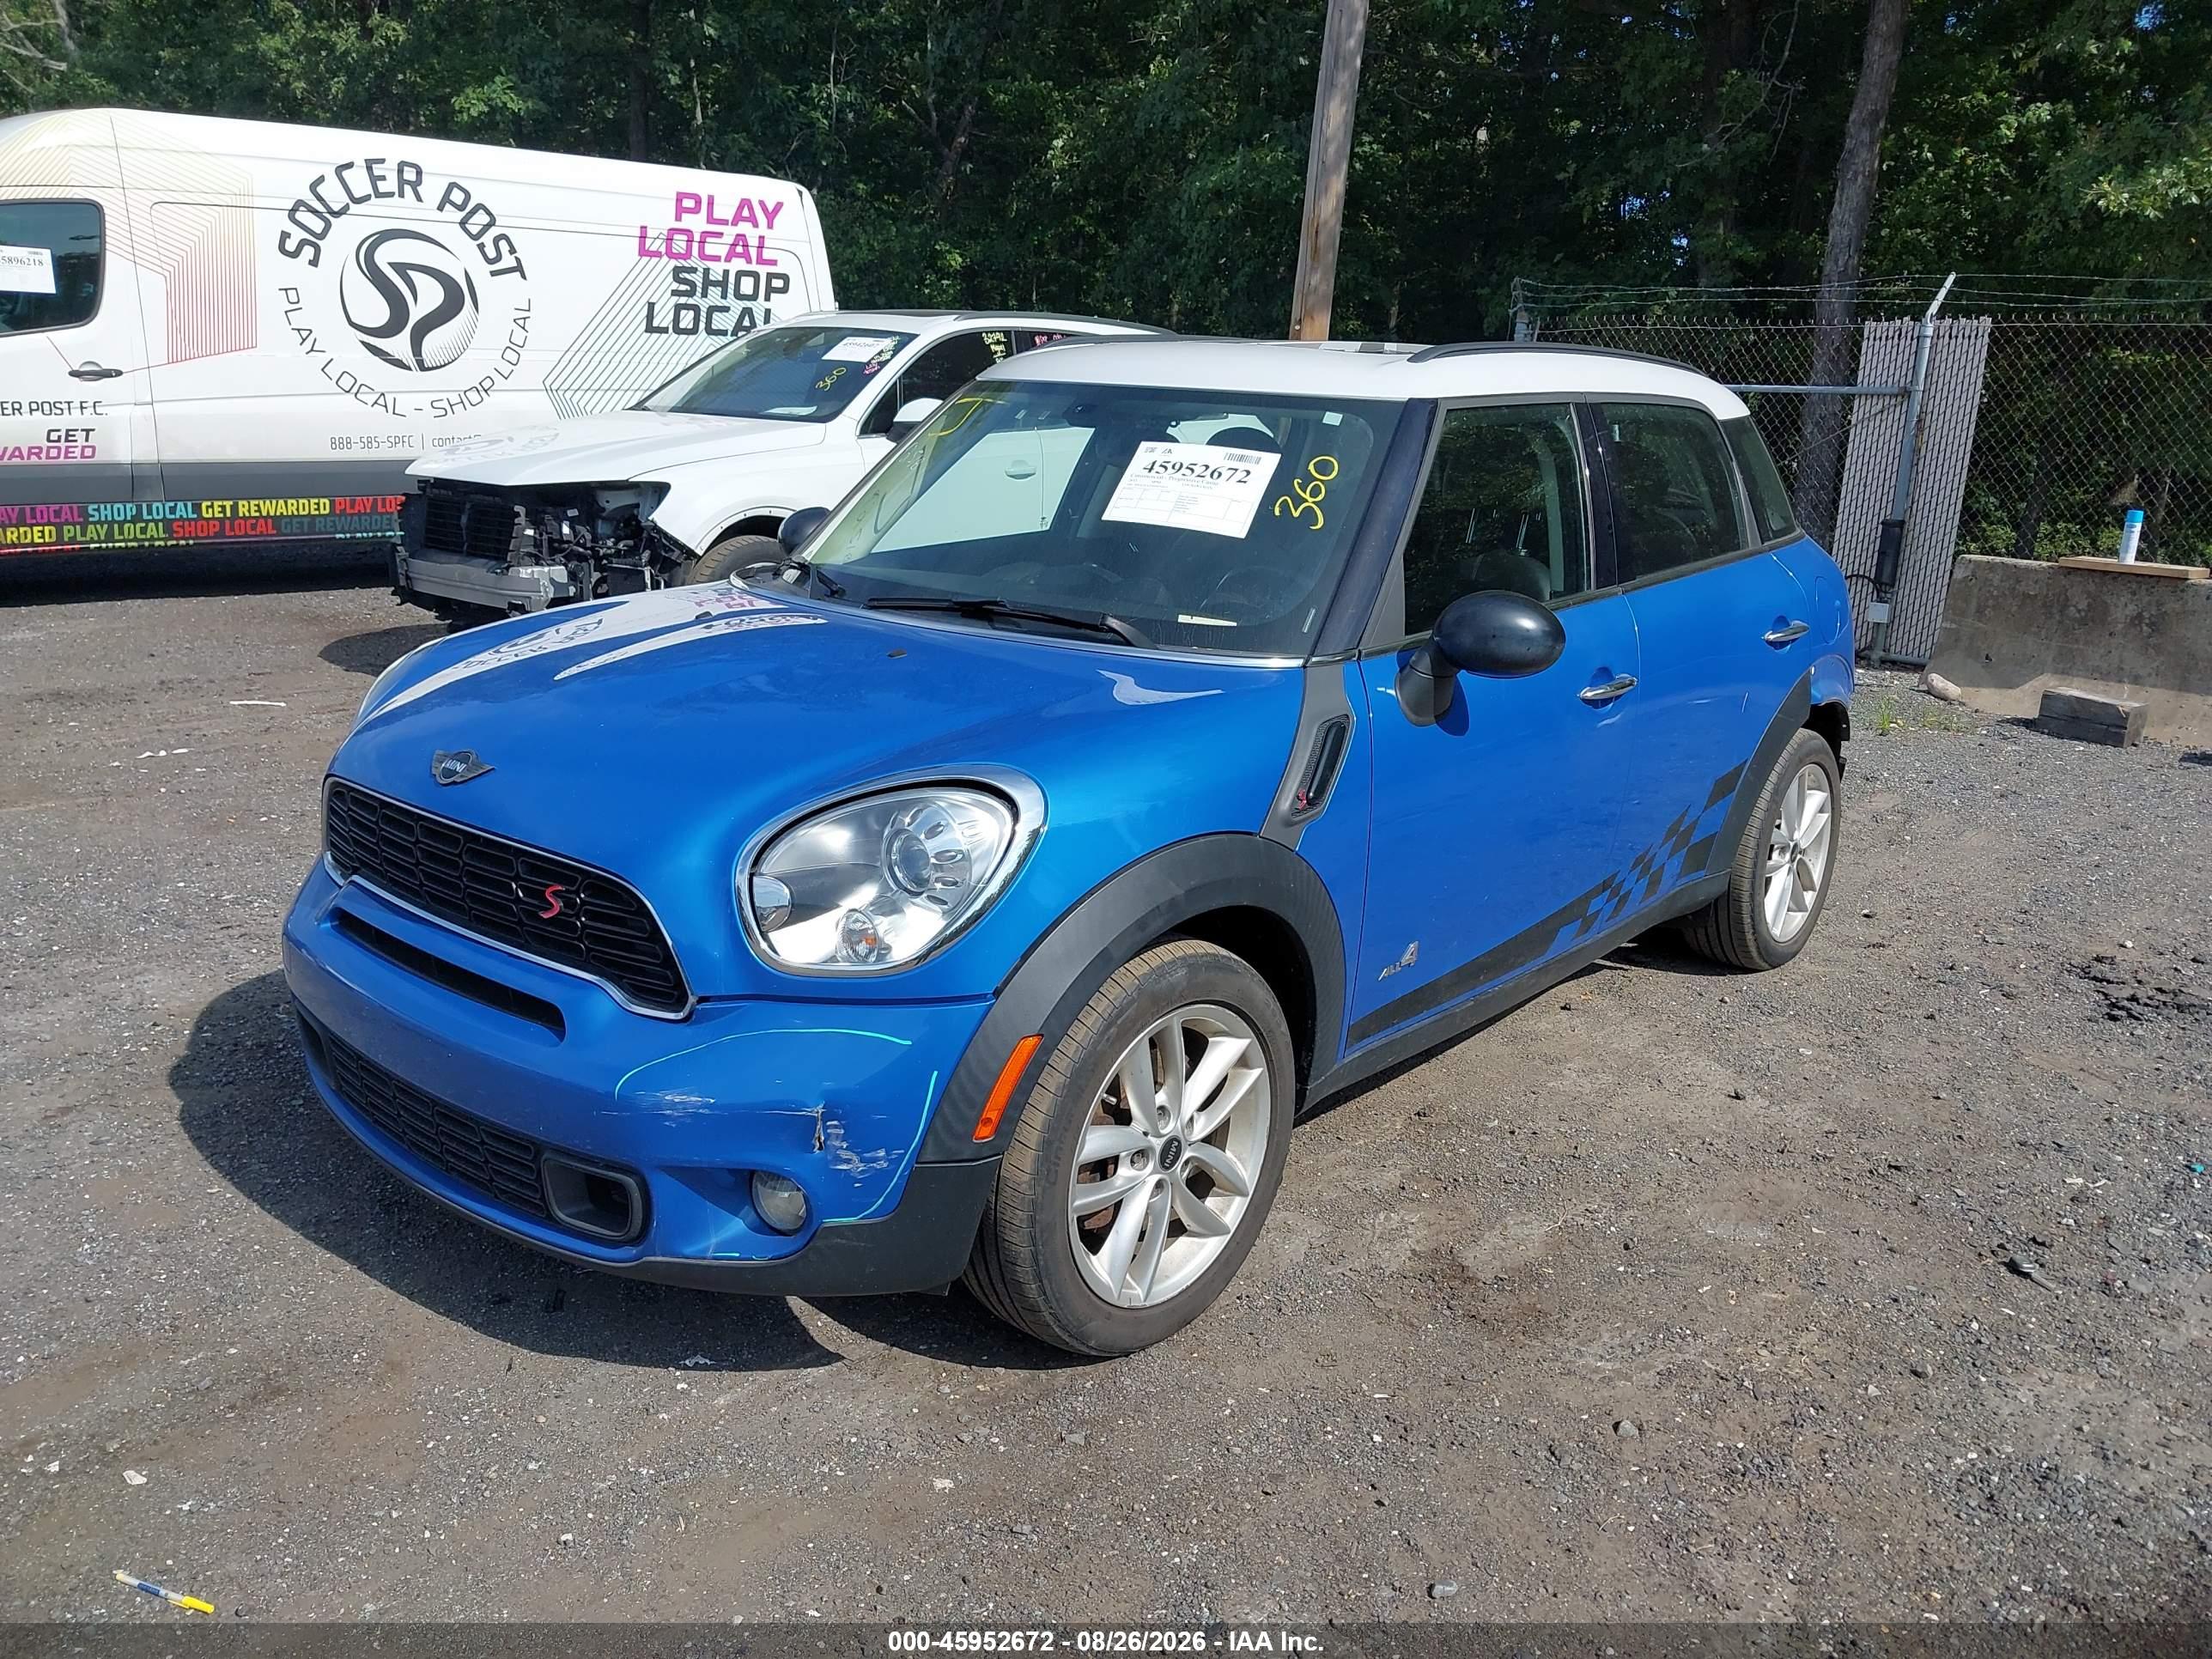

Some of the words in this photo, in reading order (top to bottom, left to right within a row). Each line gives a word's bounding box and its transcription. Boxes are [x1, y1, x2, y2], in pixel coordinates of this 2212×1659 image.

[278, 158, 423, 268] SOCCER
[436, 181, 527, 281] POST
[675, 191, 784, 229] PLAY
[638, 226, 778, 266] LOCAL
[0, 256, 44, 266] 5896218
[671, 266, 790, 302] SHOP
[278, 287, 326, 355] PLAY
[321, 358, 406, 417] LOCAL
[430, 376, 495, 417] SHOP
[494, 298, 531, 380] LOCAL
[816, 368, 847, 391] 360
[0, 401, 22, 416] ER
[28, 401, 74, 416] POST
[80, 401, 108, 416] F.C.
[46, 428, 96, 443] GET
[331, 434, 415, 450] 888-585-SPFC
[1143, 460, 1251, 483] 45952672
[1274, 456, 1339, 529] 360
[24, 505, 83, 523] LOCAL
[88, 503, 137, 521] SHOP
[143, 501, 198, 520] LOCAL
[201, 501, 233, 519] GET
[238, 498, 331, 517] REWARDED
[335, 496, 373, 514] PLAY
[64, 524, 108, 542] PLAY
[113, 522, 167, 539] LOCAL
[173, 520, 220, 538] SHOP
[225, 519, 276, 536] LOCAL
[281, 518, 312, 533] GET
[445, 759, 467, 773] MINI
[538, 884, 565, 919] S
[1164, 1140, 1179, 1167] MINI
